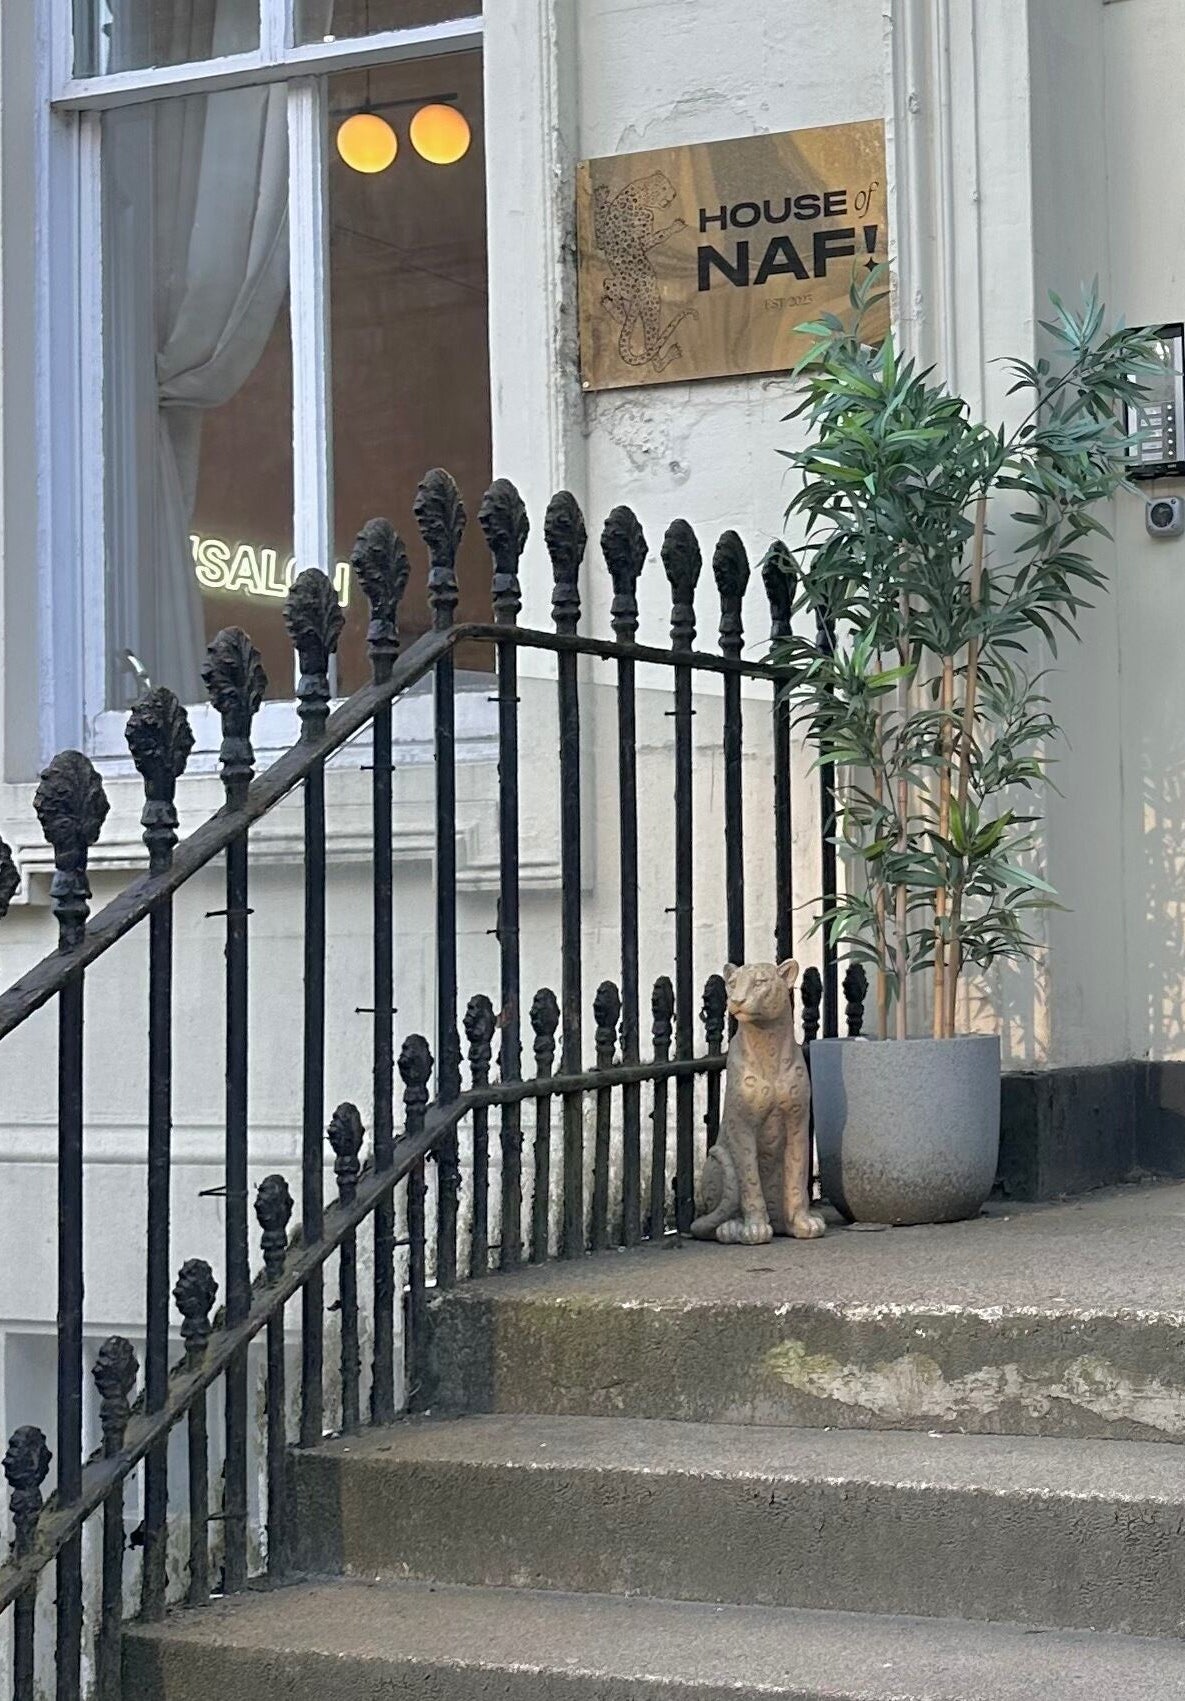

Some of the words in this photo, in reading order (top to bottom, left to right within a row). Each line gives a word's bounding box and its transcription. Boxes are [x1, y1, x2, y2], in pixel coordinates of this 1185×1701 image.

[699, 190, 847, 232] HOUSE
[854, 181, 880, 219] of
[697, 224, 880, 292] NAF!
[762, 297, 786, 310] EST
[195, 539, 350, 607] SAL
